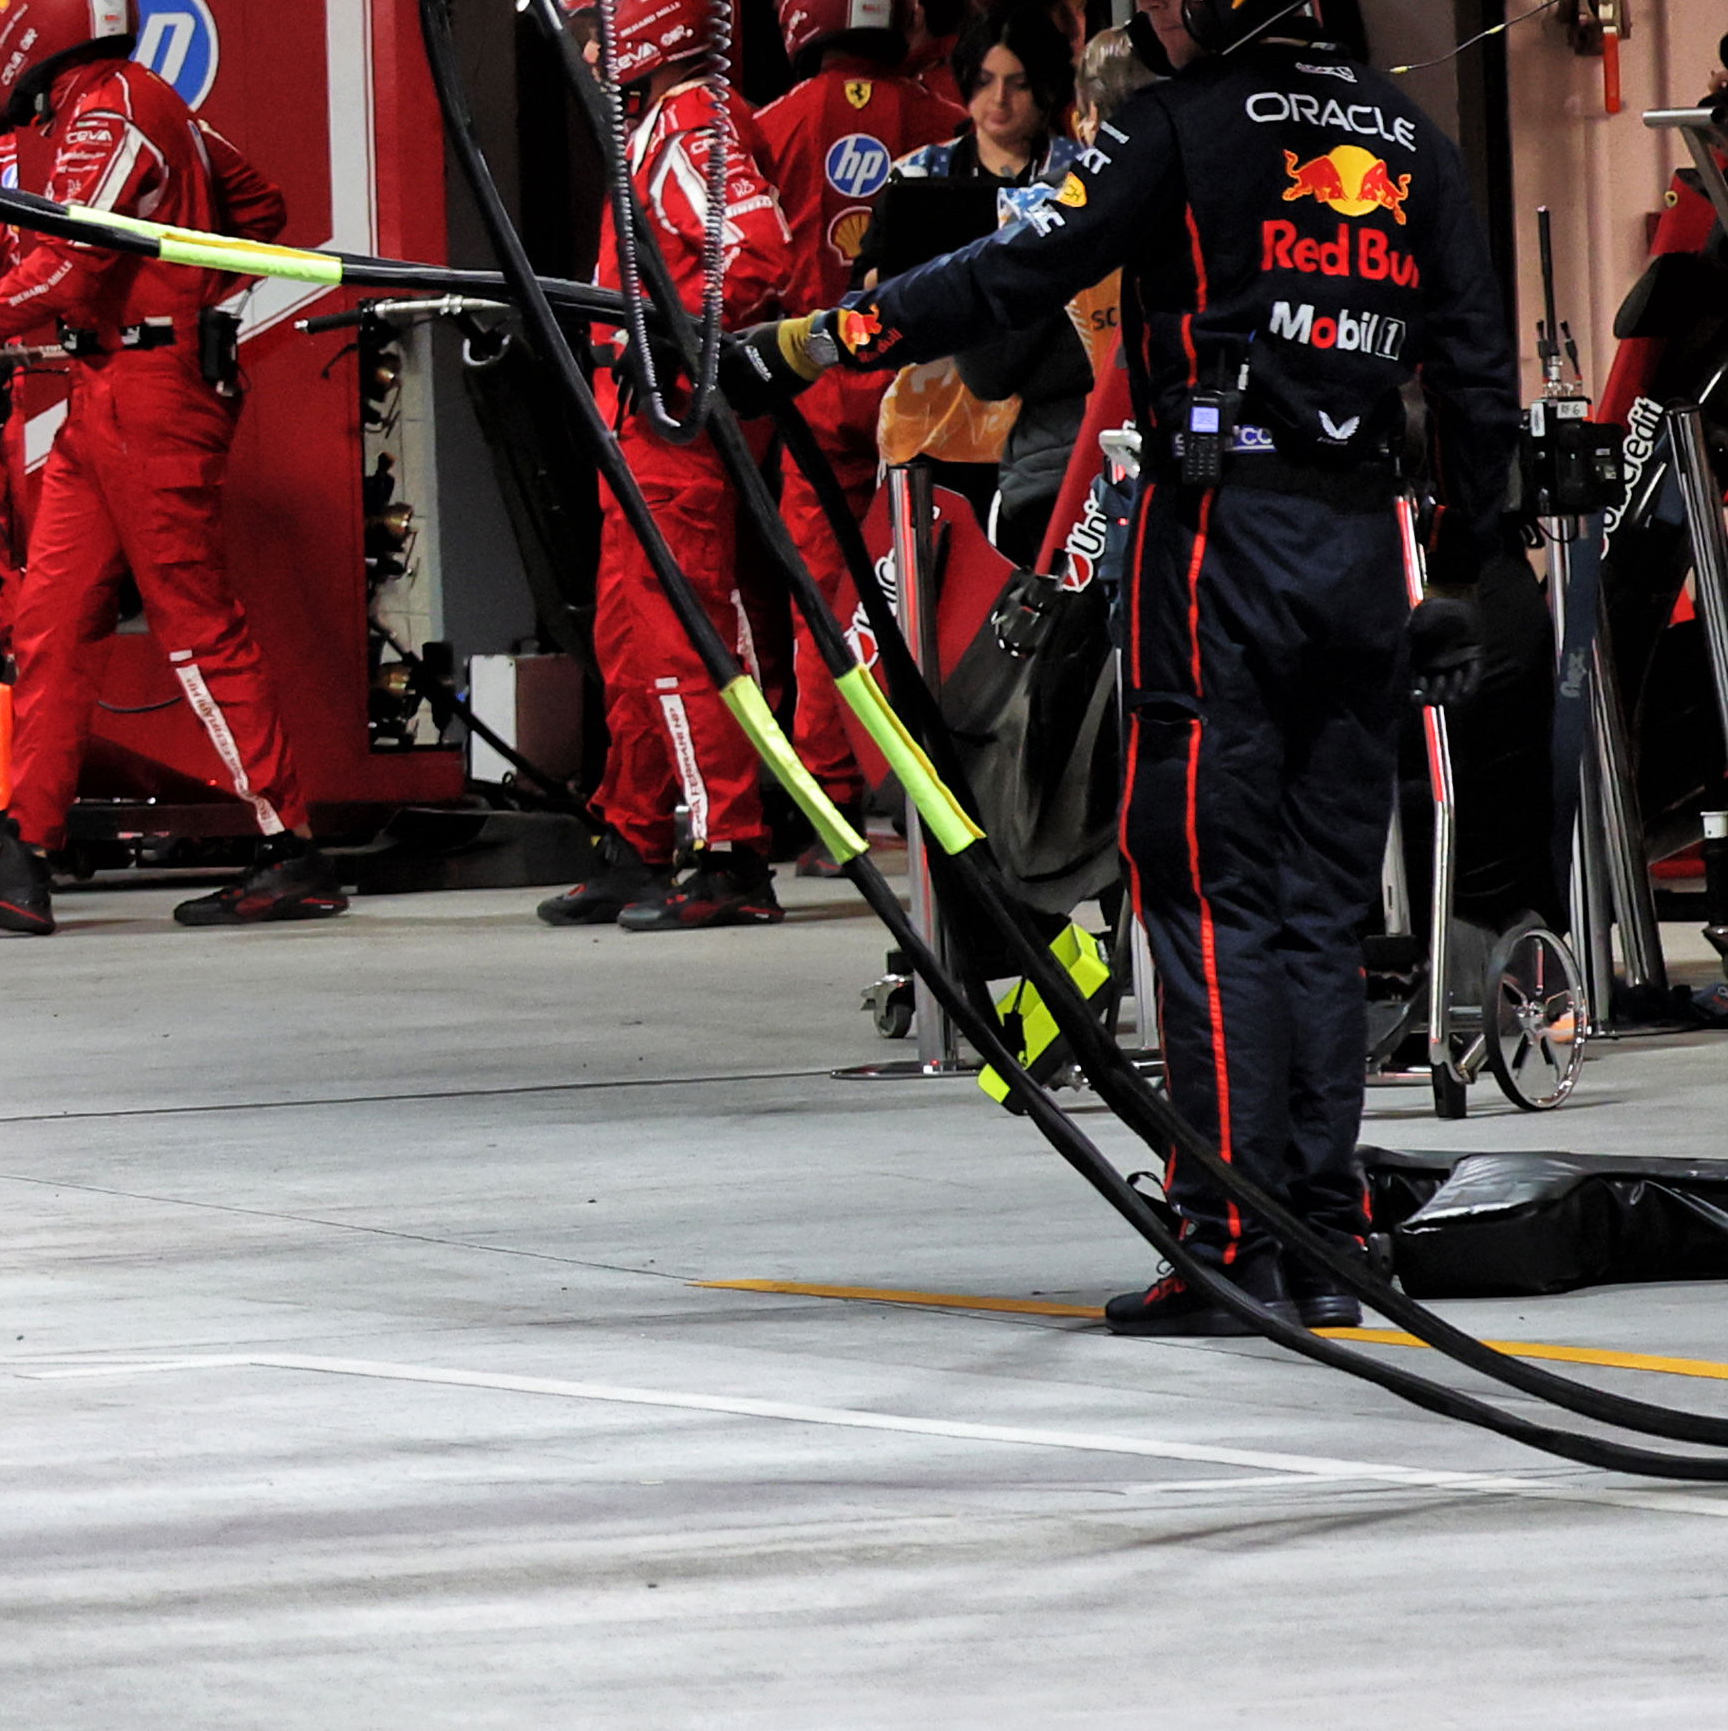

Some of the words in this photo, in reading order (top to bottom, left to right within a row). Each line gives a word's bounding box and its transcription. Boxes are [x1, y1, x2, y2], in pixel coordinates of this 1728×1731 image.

[1246, 92, 1418, 152] ORACLE
[830, 135, 886, 197] hp
[1261, 219, 1349, 276] Red
[1269, 301, 1373, 357] Mobil
